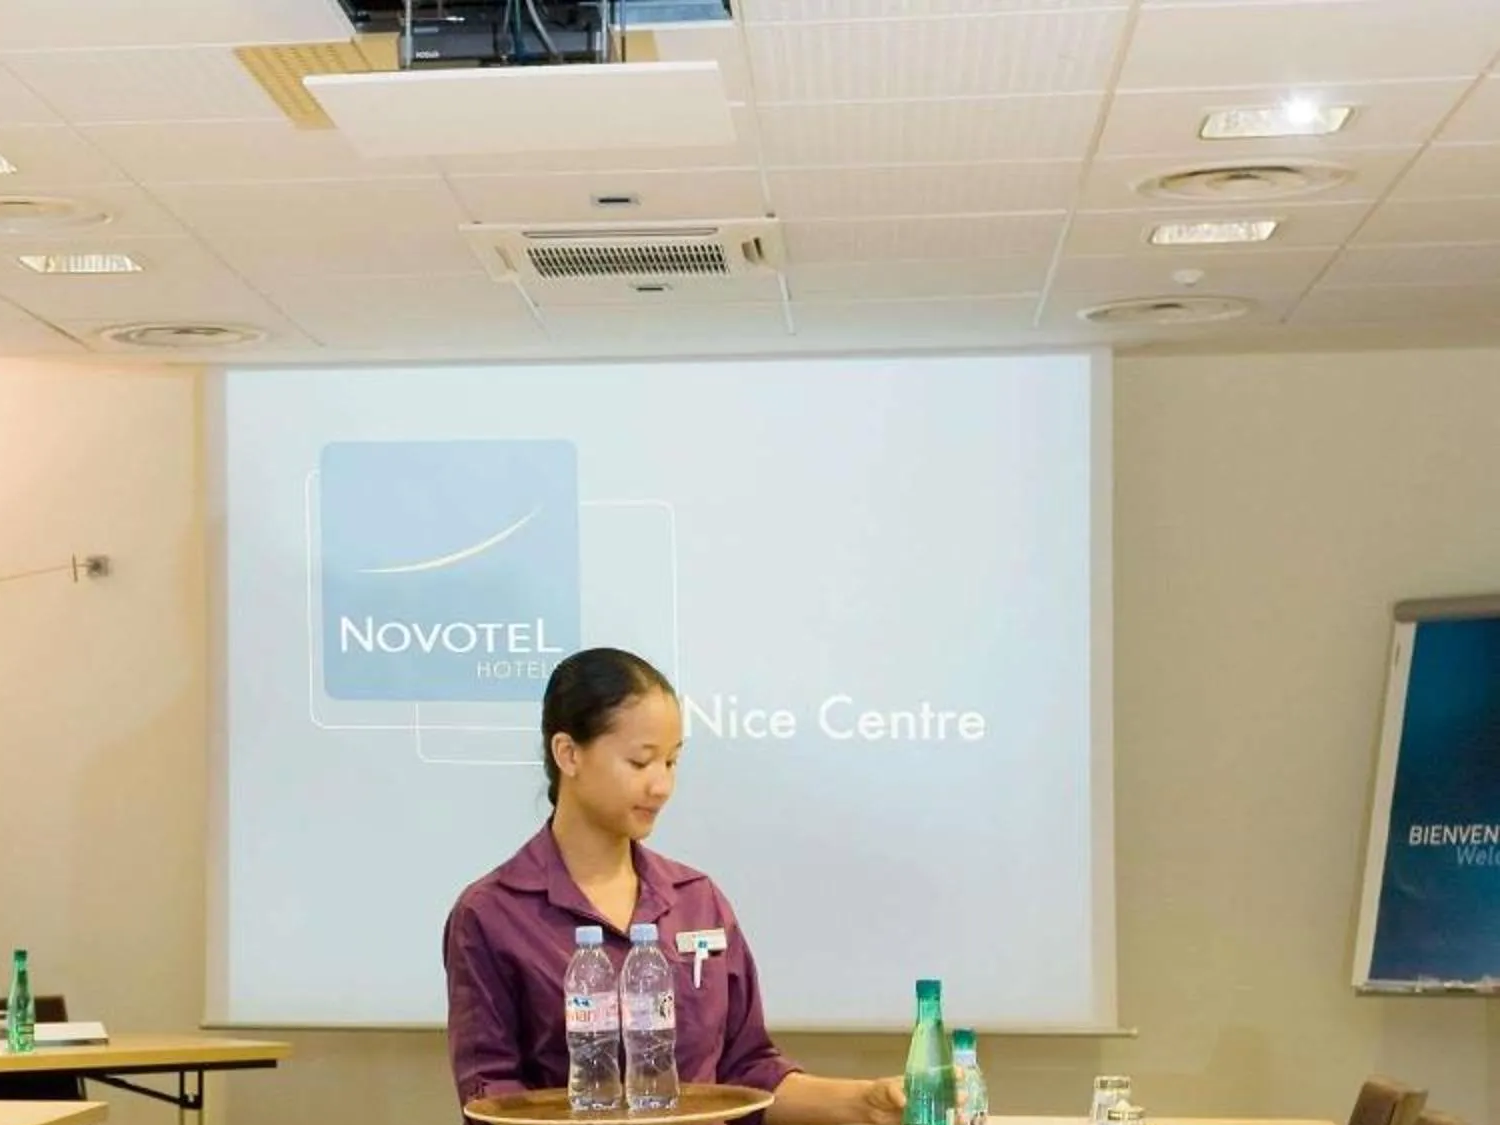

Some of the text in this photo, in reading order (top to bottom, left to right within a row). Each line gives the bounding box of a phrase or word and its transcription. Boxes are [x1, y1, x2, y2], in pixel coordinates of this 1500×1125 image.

[340, 615, 564, 653] NOVOTEL
[477, 660, 558, 679] HOTEL
[683, 694, 987, 740] Nice Centre
